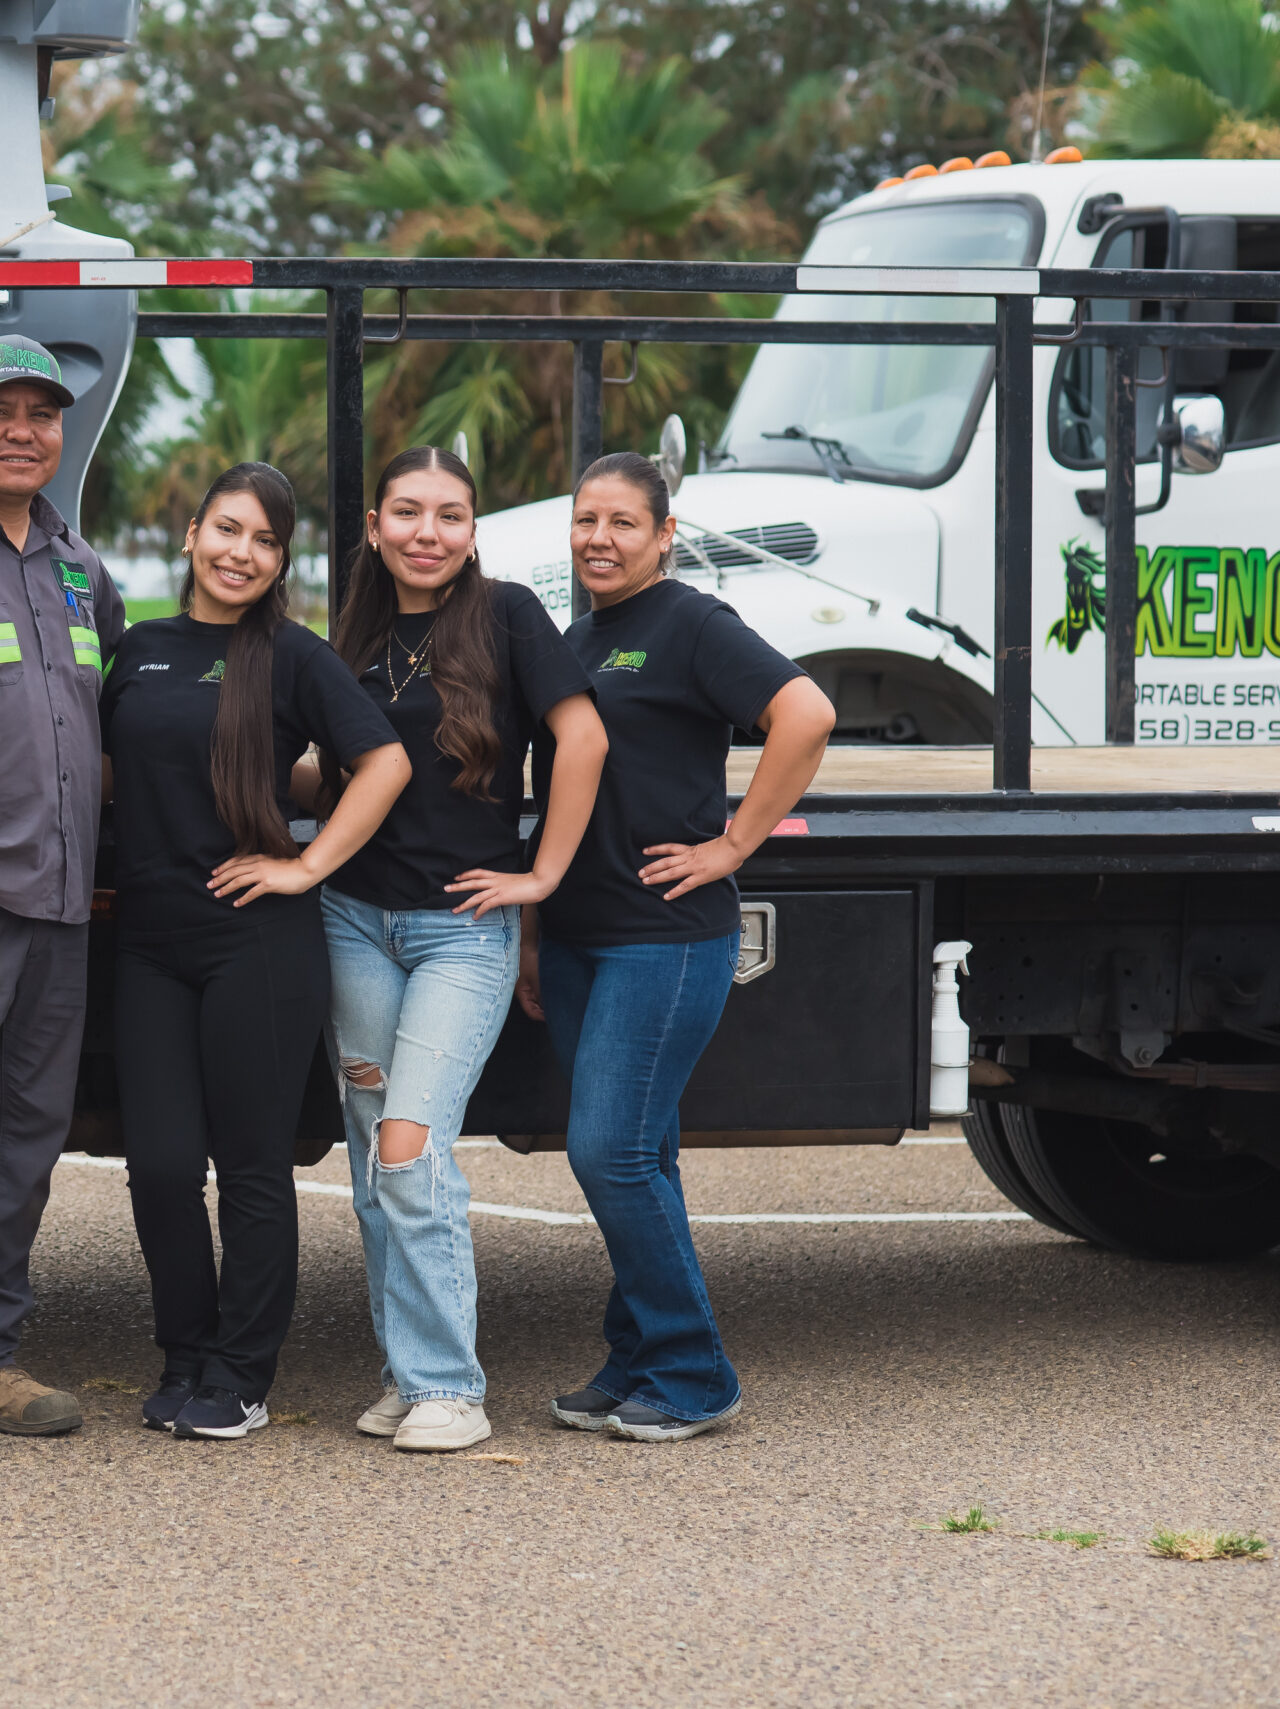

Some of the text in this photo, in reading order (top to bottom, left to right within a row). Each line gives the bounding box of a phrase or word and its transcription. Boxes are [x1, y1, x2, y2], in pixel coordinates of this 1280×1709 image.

[16, 349, 51, 376] KENO
[532, 561, 569, 585] 6312
[139, 663, 170, 672] MYRIAM
[613, 651, 647, 668] KENO
[1135, 684, 1280, 706] RTABLE SER
